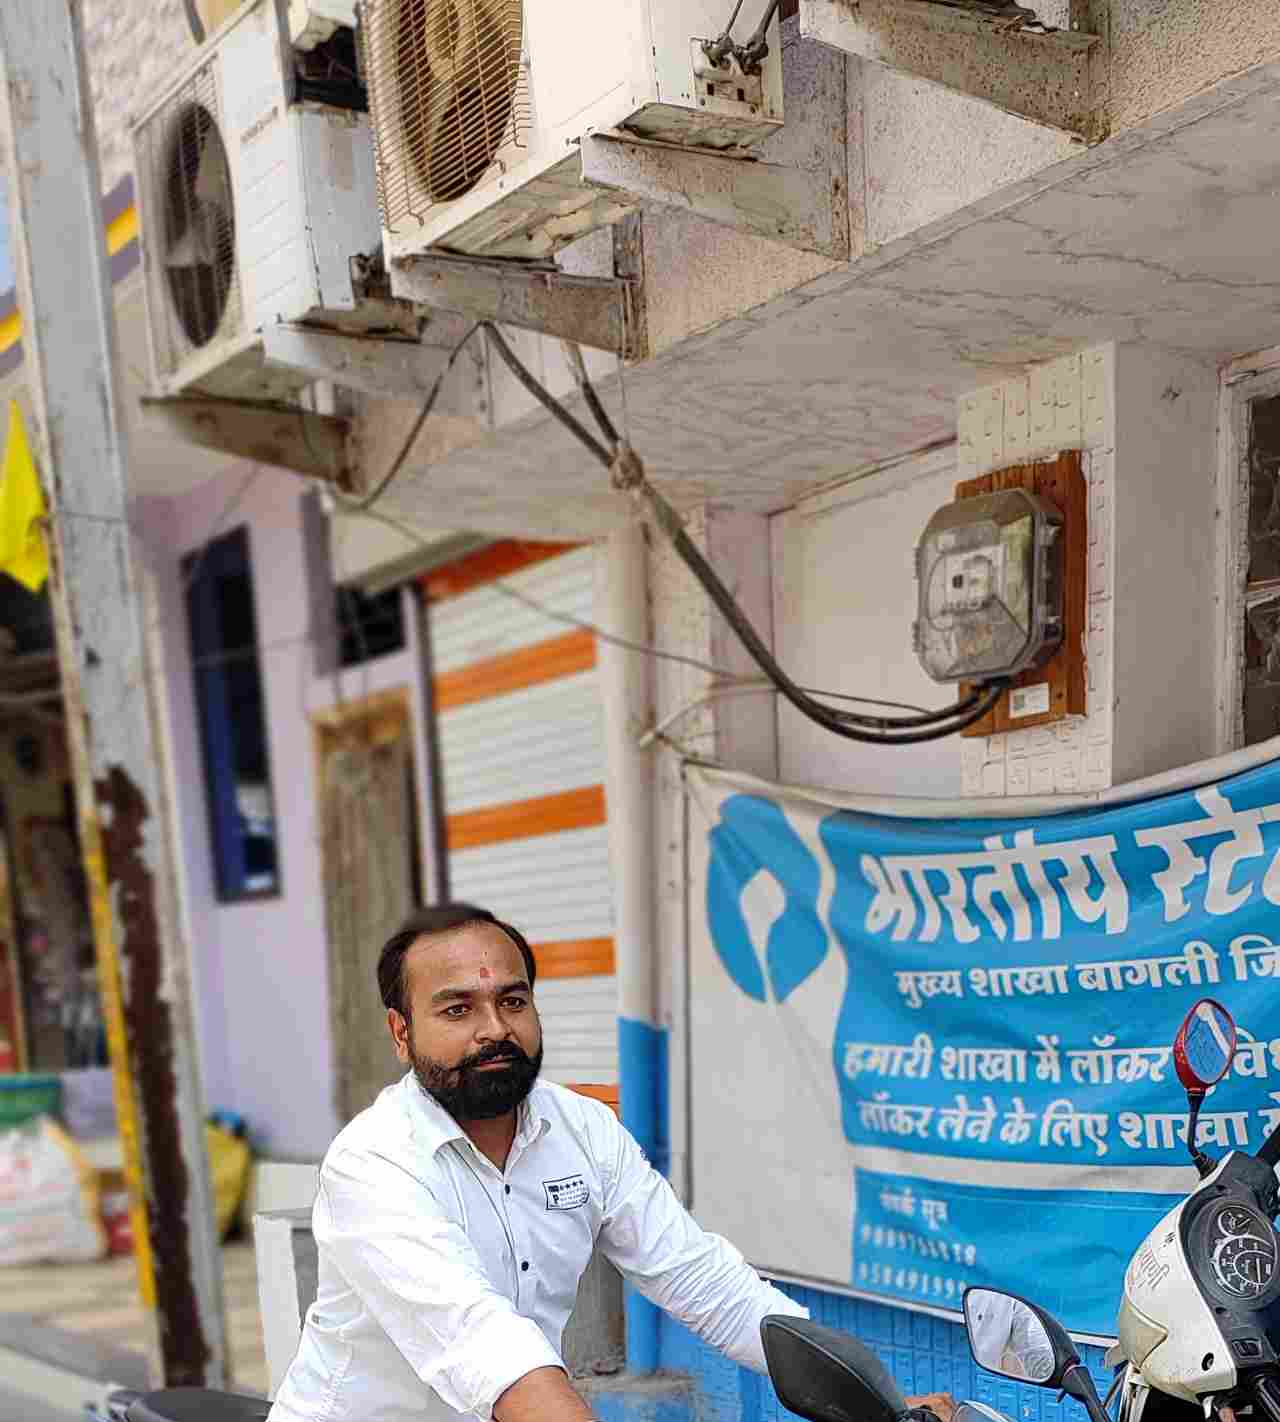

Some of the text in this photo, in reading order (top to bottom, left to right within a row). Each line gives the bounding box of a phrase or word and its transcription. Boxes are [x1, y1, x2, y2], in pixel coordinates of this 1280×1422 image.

[861, 828, 1129, 943] भारतीय
[896, 969, 963, 1008] मुख्य
[969, 964, 1069, 997] शाखा
[1074, 940, 1220, 992] बागली
[843, 1033, 933, 1079] हमारी
[940, 1043, 1027, 1083] शाखा
[1033, 1034, 1062, 1083] में
[1066, 1034, 1174, 1084] लॉकर
[856, 1092, 934, 1138] लॉकर
[938, 1096, 997, 1144] लेने
[999, 1096, 1037, 1145] के
[1039, 1099, 1110, 1156] लिए
